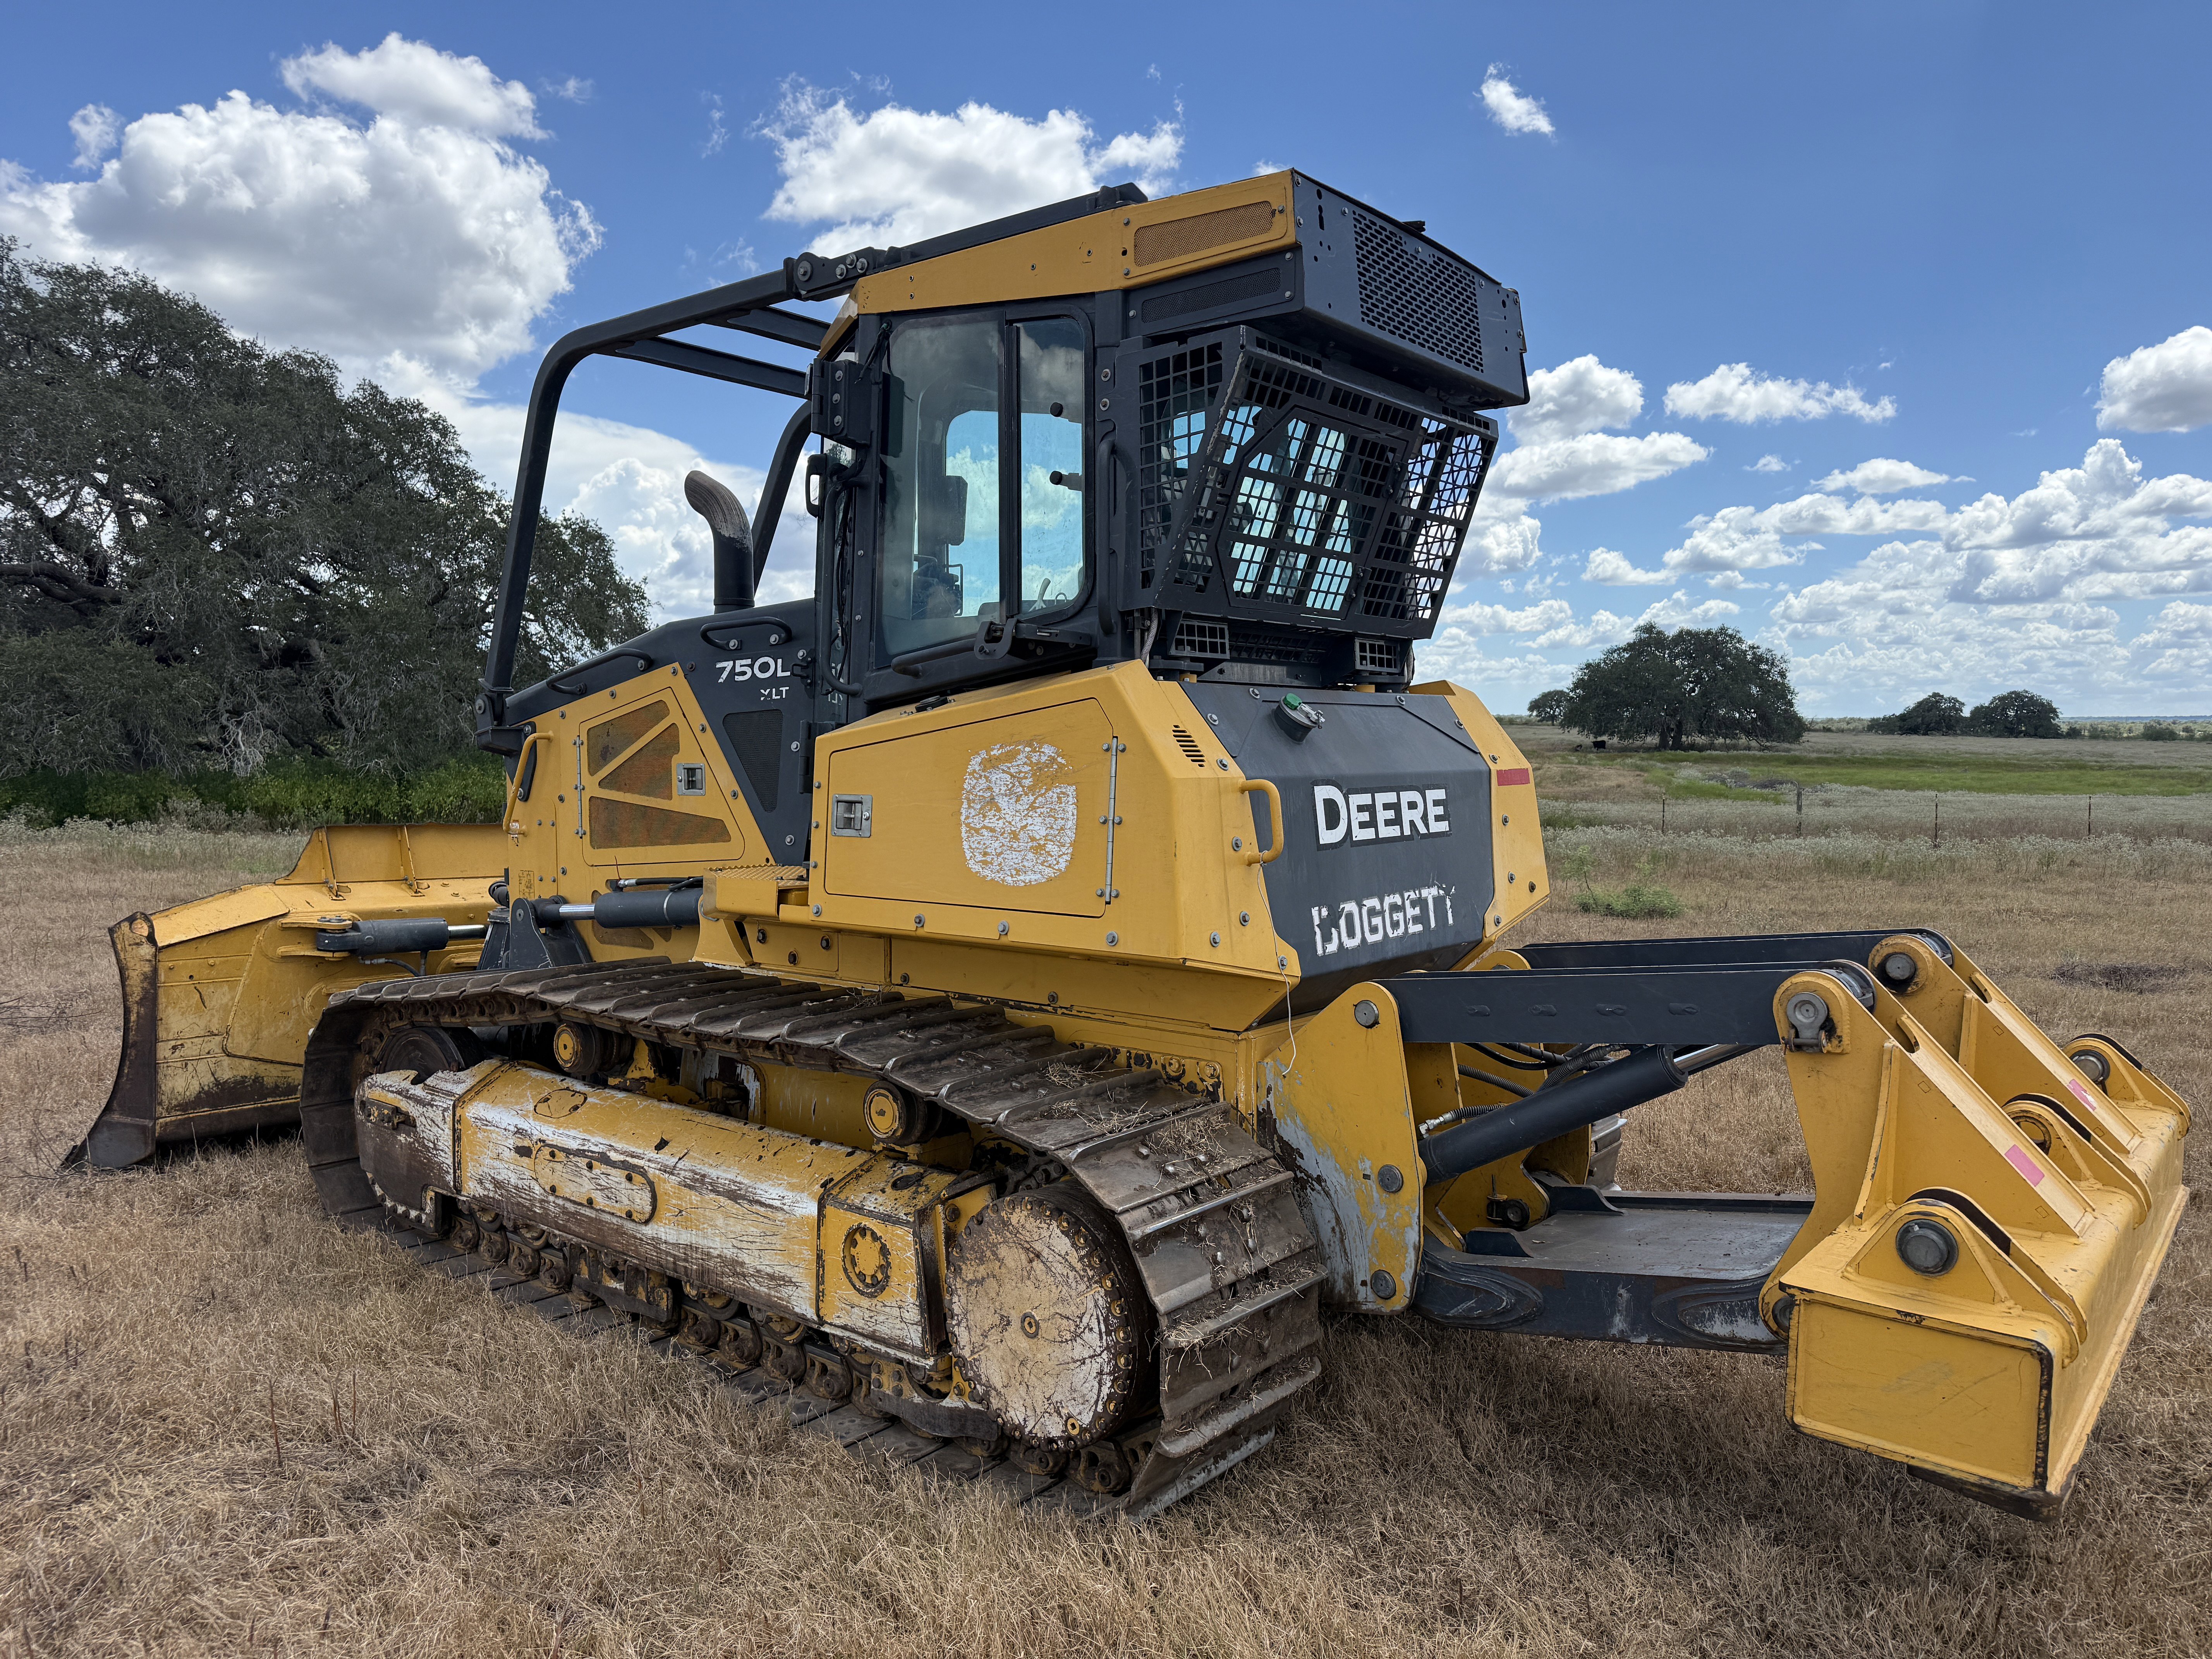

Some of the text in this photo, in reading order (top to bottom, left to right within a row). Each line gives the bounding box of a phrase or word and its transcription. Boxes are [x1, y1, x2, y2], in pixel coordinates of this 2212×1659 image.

[716, 656, 790, 683] 750L
[760, 687, 789, 701] XLT
[1314, 785, 1449, 844] DEERE
